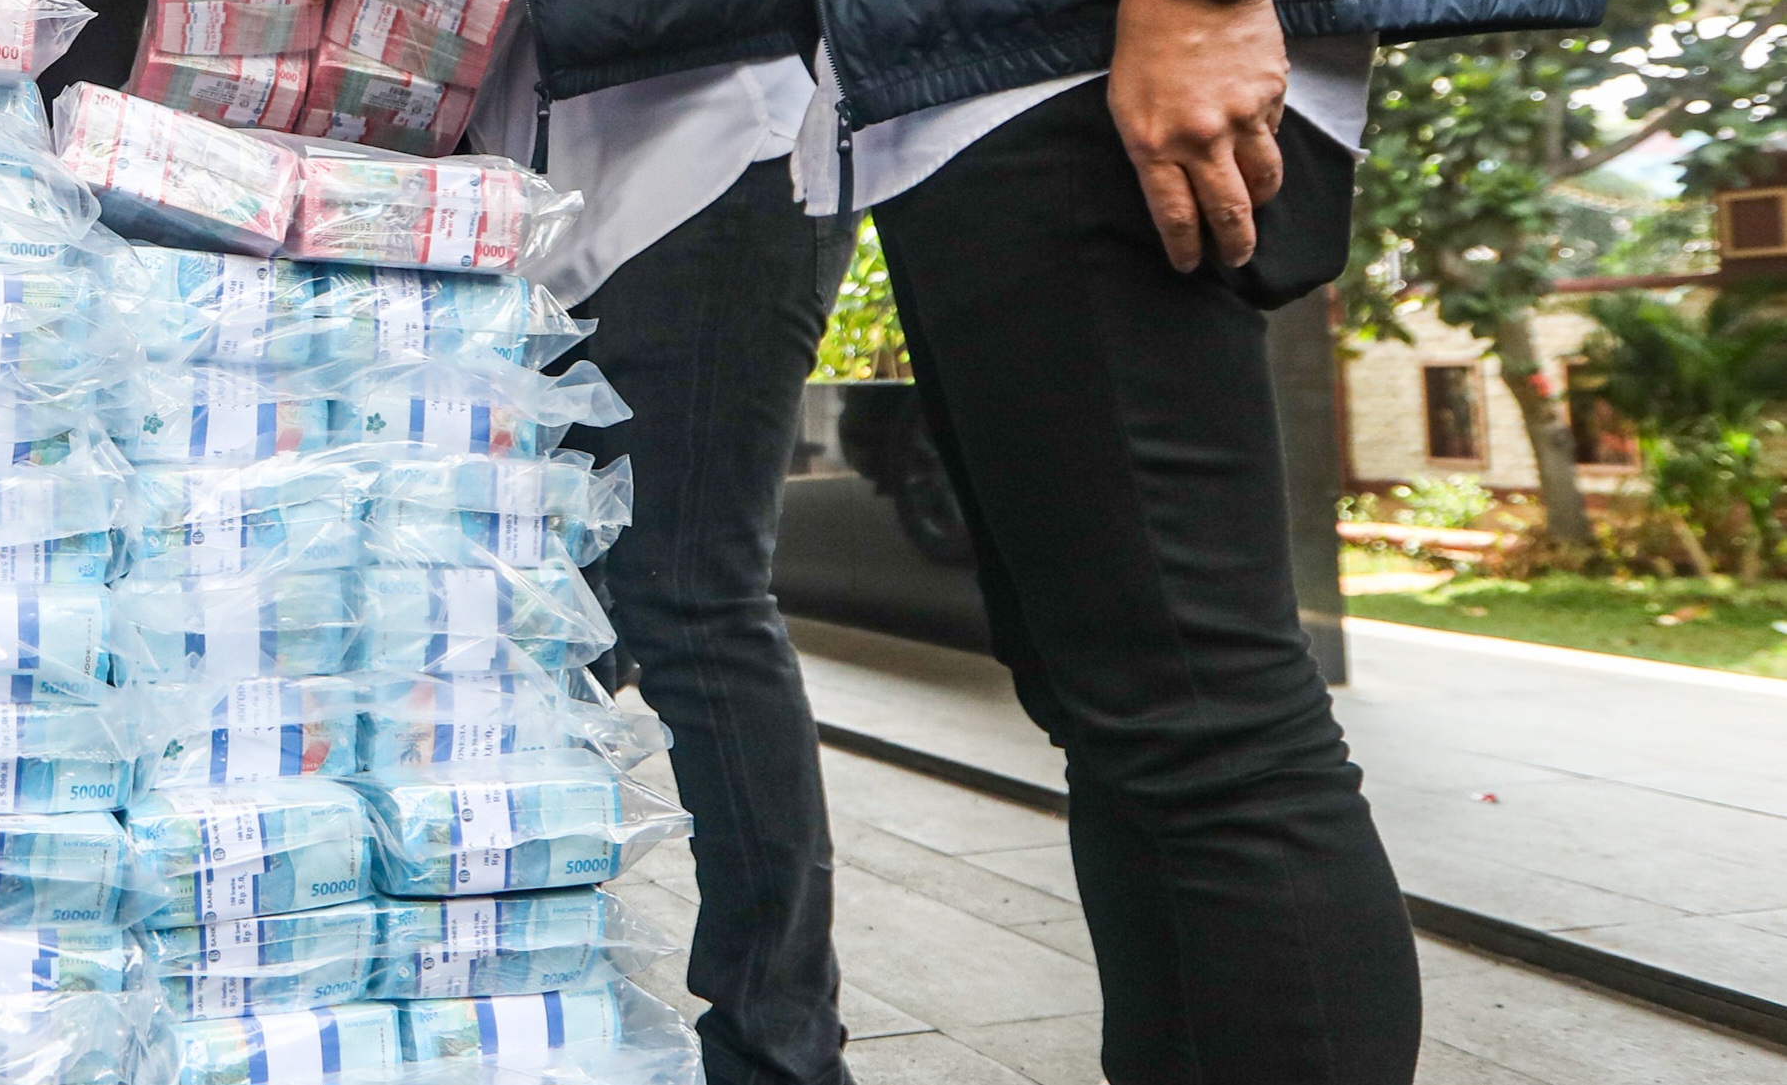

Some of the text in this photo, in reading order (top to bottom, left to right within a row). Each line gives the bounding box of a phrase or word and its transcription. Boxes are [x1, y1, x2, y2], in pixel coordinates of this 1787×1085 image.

[70, 784, 115, 801] 50000
[245, 826, 254, 840] Rp
[491, 853, 500, 866] Rp
[565, 857, 610, 875] 50000
[311, 878, 356, 898] 50000
[206, 887, 214, 909] BANK
[238, 891, 247, 905] Rp
[53, 907, 101, 921] 50000
[243, 931, 252, 943] Rp
